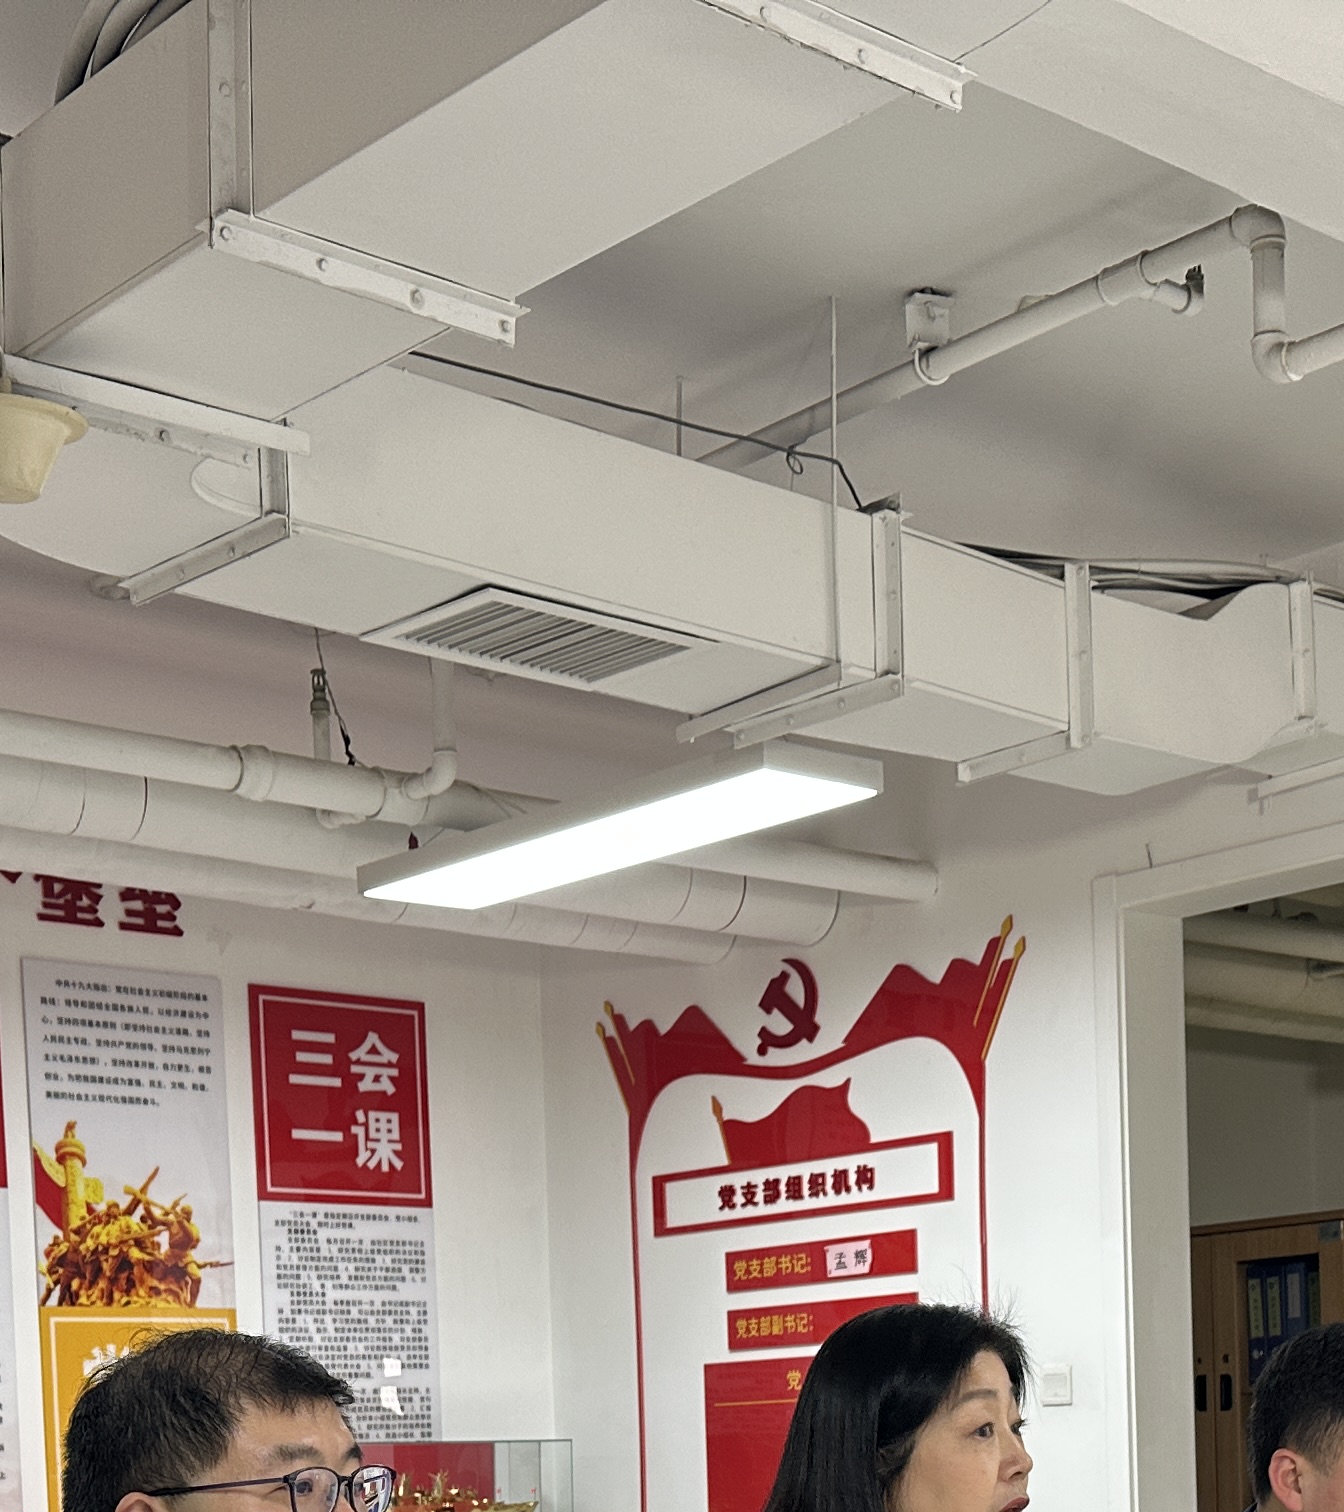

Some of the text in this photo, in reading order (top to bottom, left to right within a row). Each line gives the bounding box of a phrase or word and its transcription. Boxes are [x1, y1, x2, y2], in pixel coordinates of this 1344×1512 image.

[288, 1028, 400, 1096] 三会
[290, 1109, 405, 1173] 一课
[717, 1164, 877, 1211] 党支部组织机构
[733, 1253, 812, 1281] 党支部书记：
[735, 1313, 814, 1339] 党支部副书记：
[786, 1369, 802, 1391] 党
